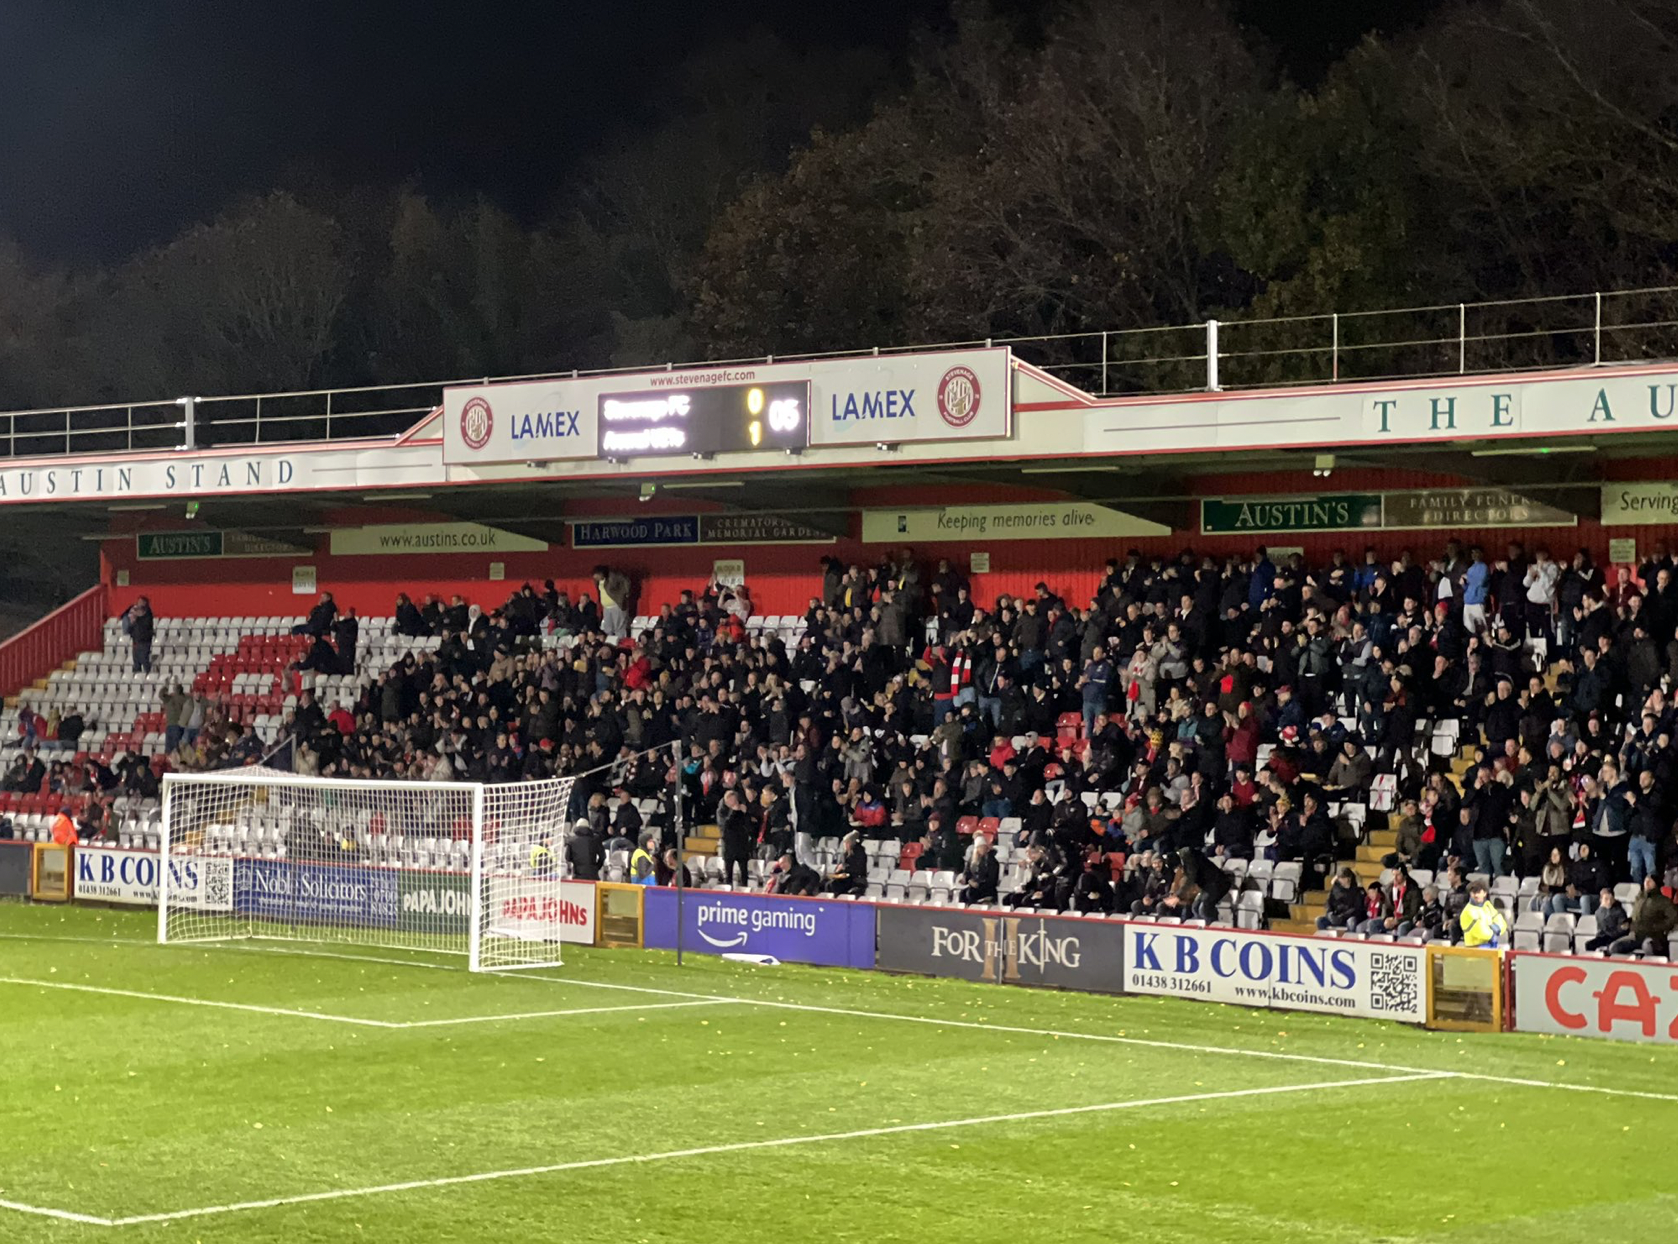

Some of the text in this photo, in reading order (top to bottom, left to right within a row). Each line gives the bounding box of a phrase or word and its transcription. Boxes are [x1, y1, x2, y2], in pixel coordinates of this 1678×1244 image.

[650, 370, 755, 387] www.stevenagefc.com
[748, 388, 764, 414] 0
[833, 389, 915, 420] LAMEX
[1373, 394, 1514, 433] THE
[511, 411, 580, 439] LAMEX
[749, 421, 762, 446] 1
[166, 460, 293, 489] STAND
[1235, 502, 1349, 528] AUSTIN'S
[1621, 491, 1678, 515] Serving
[580, 521, 692, 541] HARWOOD PARK
[707, 527, 767, 539] MEMORIAL
[717, 516, 791, 528] CREMATORI
[937, 511, 987, 532] Keeping
[992, 512, 1056, 528] memories
[150, 536, 211, 554] AUSTIN'S
[380, 528, 496, 548] www.austins.co.uk
[79, 853, 95, 882] K
[100, 855, 115, 883] B
[301, 872, 367, 901] Solicitors
[698, 900, 816, 936] prime gaming
[1133, 931, 1356, 990] K B COINS
[1132, 973, 1212, 993] 01438 312661
[1234, 985, 1356, 1009] www.kbcoins.com
[1545, 966, 1678, 1040] CA
